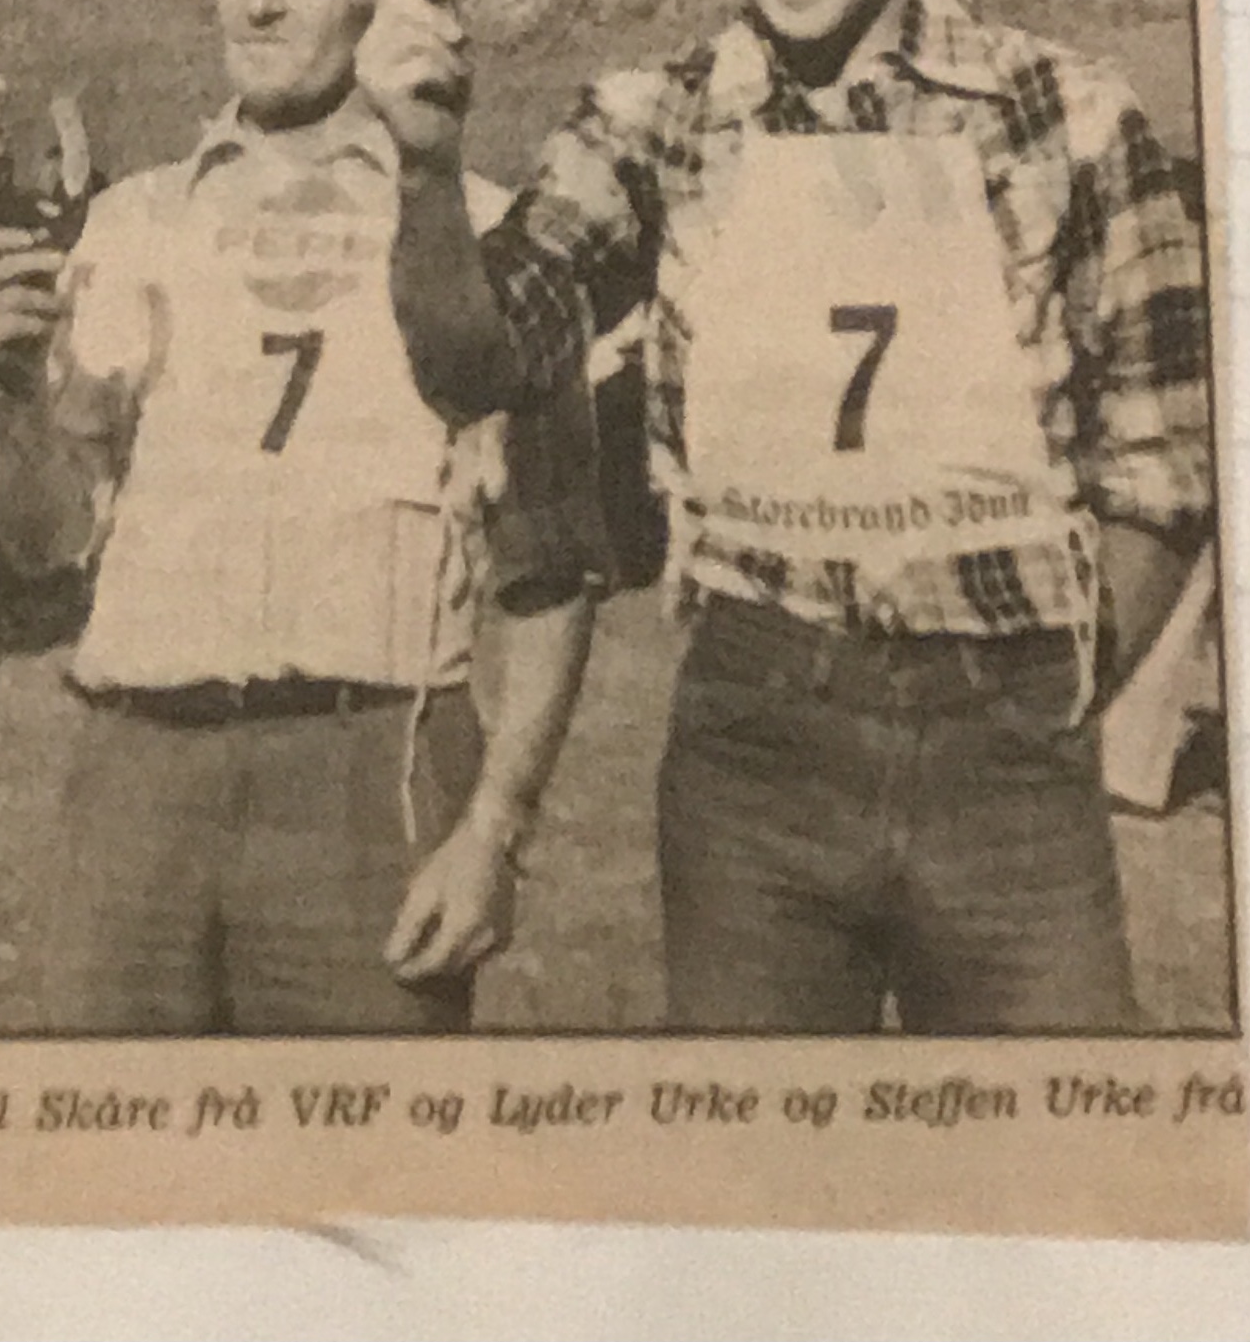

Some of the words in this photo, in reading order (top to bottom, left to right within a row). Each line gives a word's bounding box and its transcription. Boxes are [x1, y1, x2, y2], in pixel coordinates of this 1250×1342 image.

[260, 329, 325, 455] 7
[828, 303, 898, 453] 7
[35, 1089, 171, 1132] Skåre
[186, 1086, 261, 1137] frå
[290, 1083, 390, 1127] VRF
[408, 1092, 465, 1135] og
[488, 1083, 624, 1134] Lyder
[650, 1081, 760, 1125] Urke
[781, 1087, 838, 1130] og
[862, 1077, 1018, 1128] Steffen
[1045, 1075, 1157, 1118] Urke
[1173, 1072, 1245, 1123] frå
